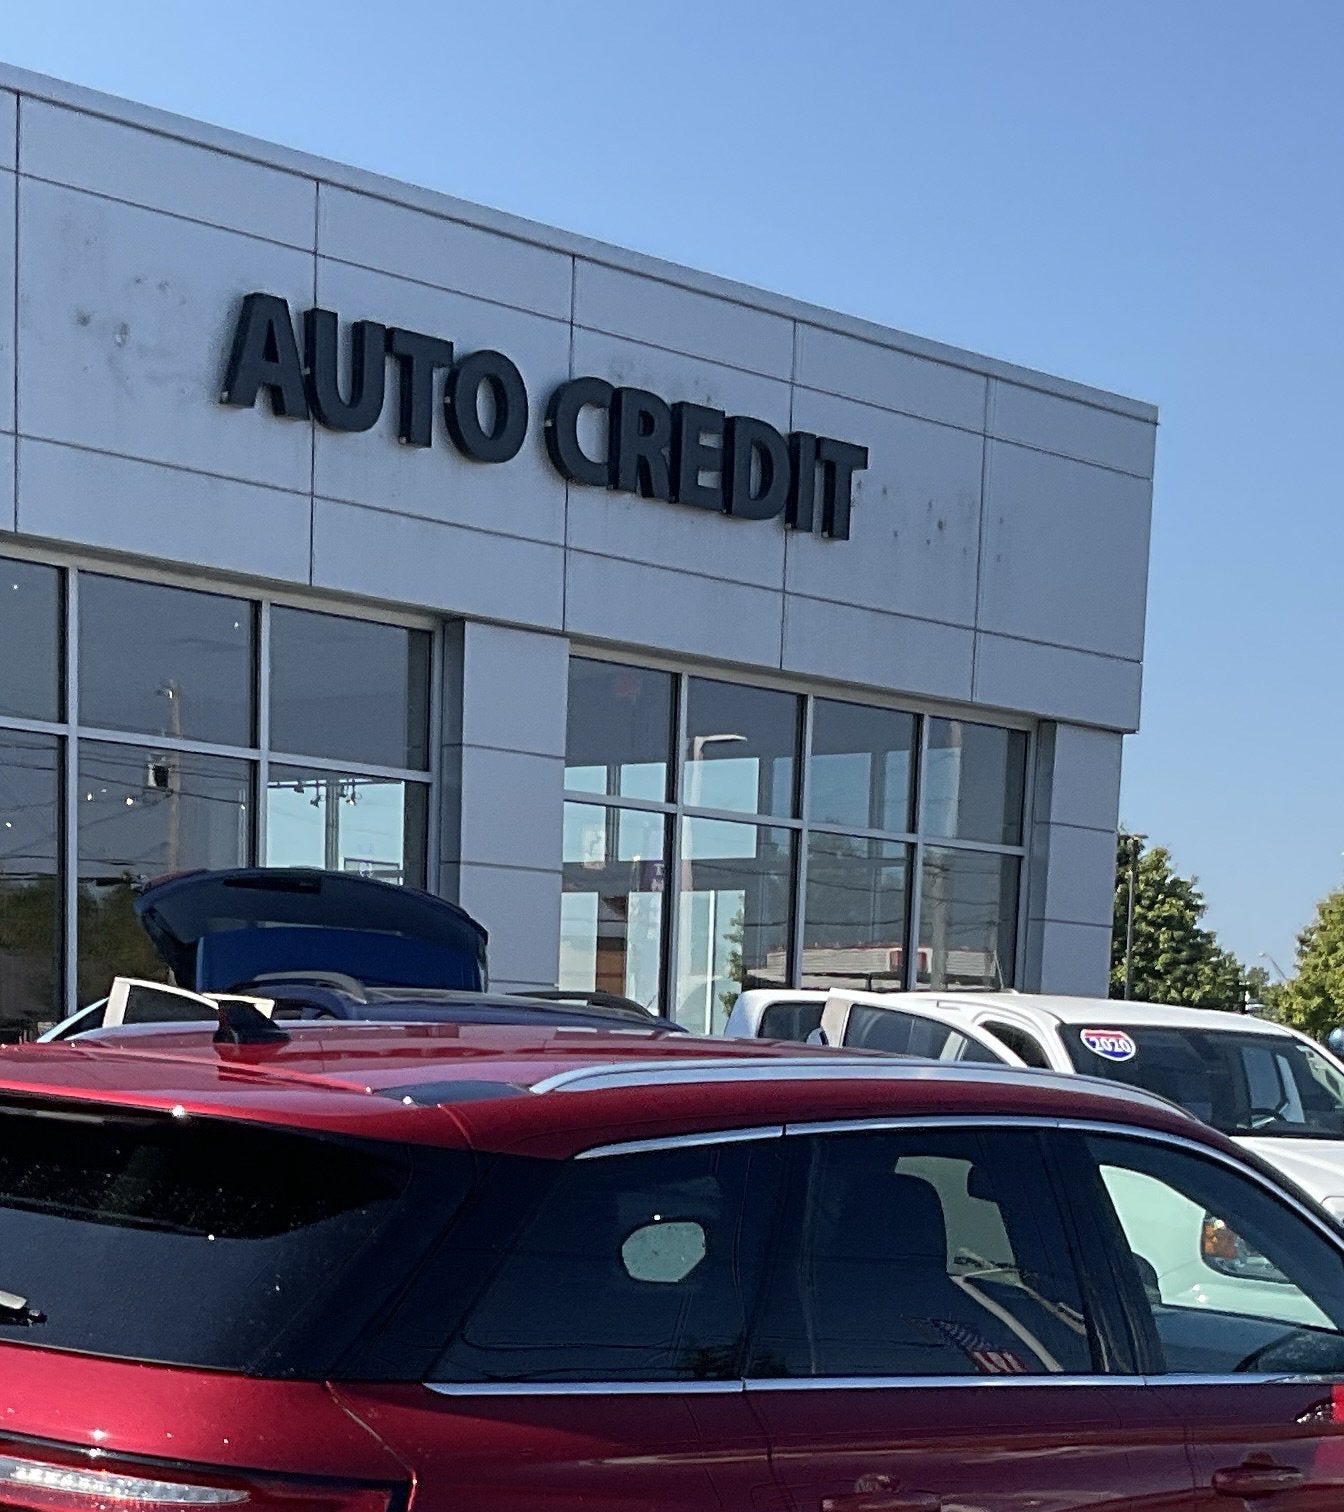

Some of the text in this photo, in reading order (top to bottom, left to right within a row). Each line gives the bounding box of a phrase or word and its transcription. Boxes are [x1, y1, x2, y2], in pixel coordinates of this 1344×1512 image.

[221, 292, 869, 541] AUTO CREDIT
[1085, 1036, 1132, 1053] 2020
